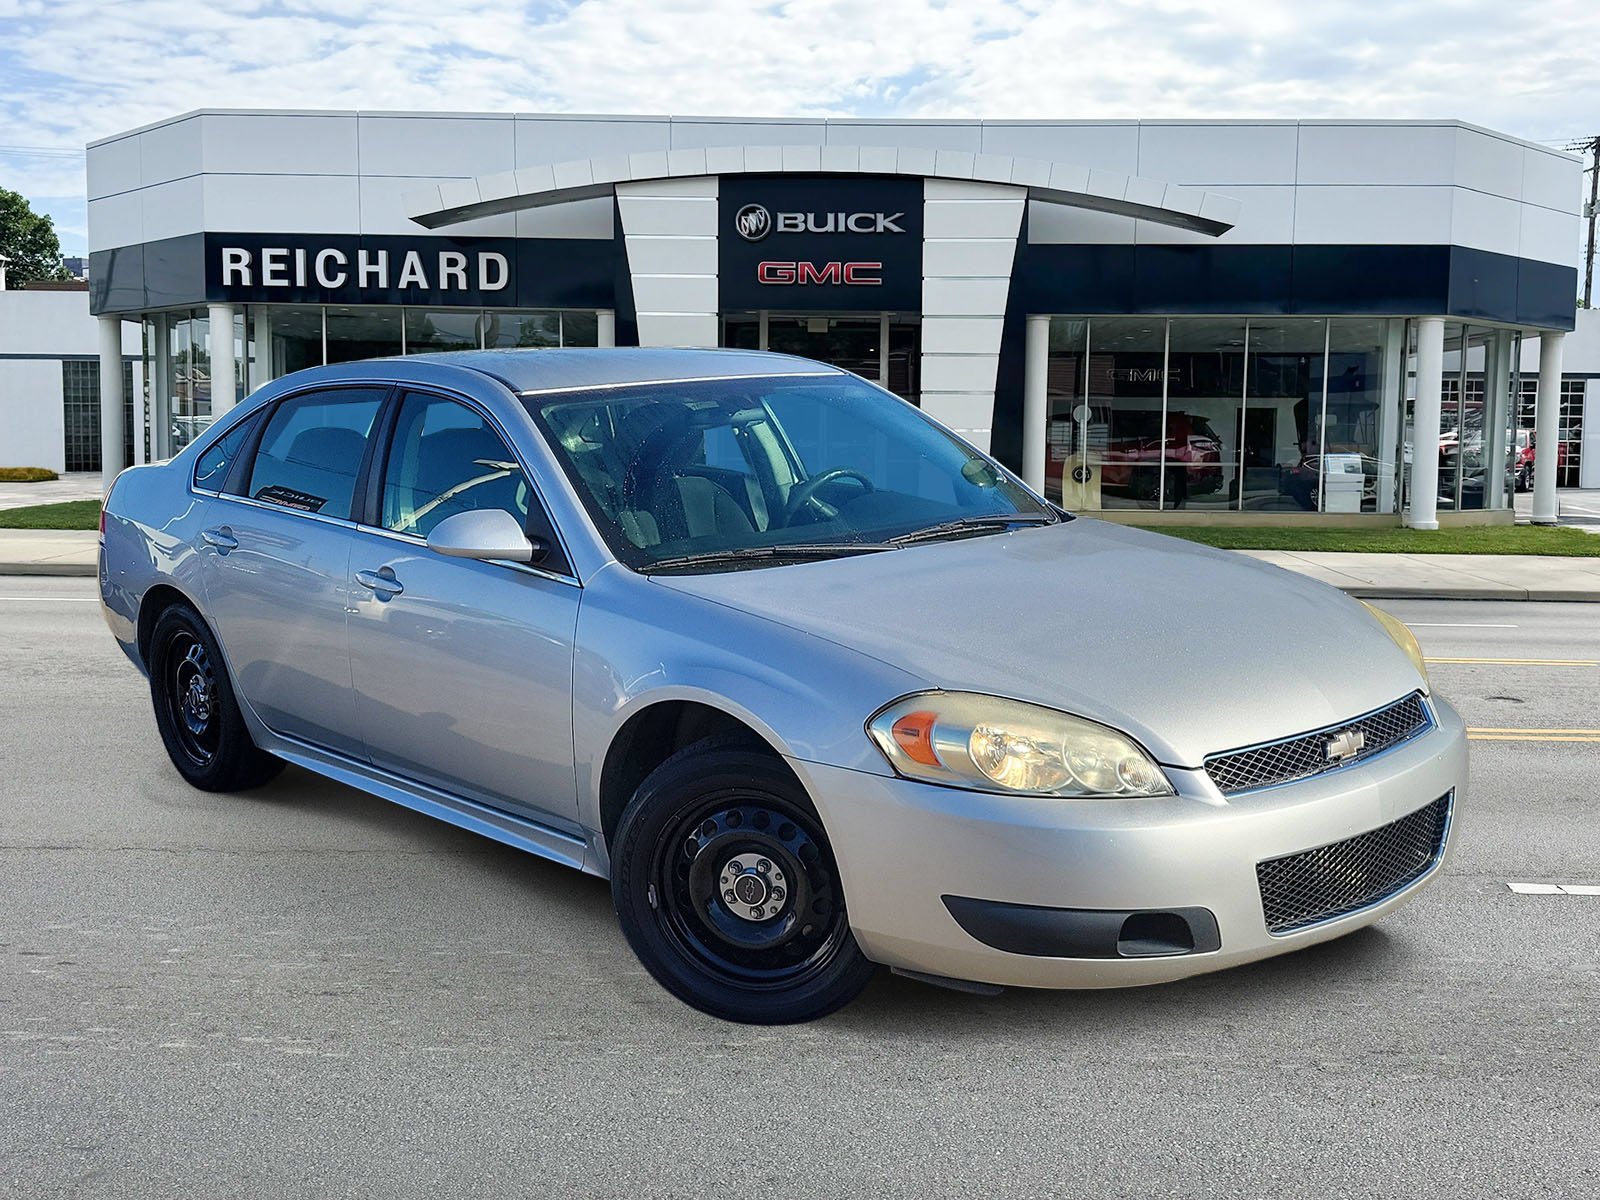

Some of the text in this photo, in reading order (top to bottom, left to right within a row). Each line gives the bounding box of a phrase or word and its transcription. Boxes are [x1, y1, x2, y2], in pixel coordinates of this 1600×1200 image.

[776, 212, 906, 233] BUICK
[221, 247, 510, 291] REICHARD
[757, 261, 882, 285] GMC
[1106, 368, 1181, 382] GMC
